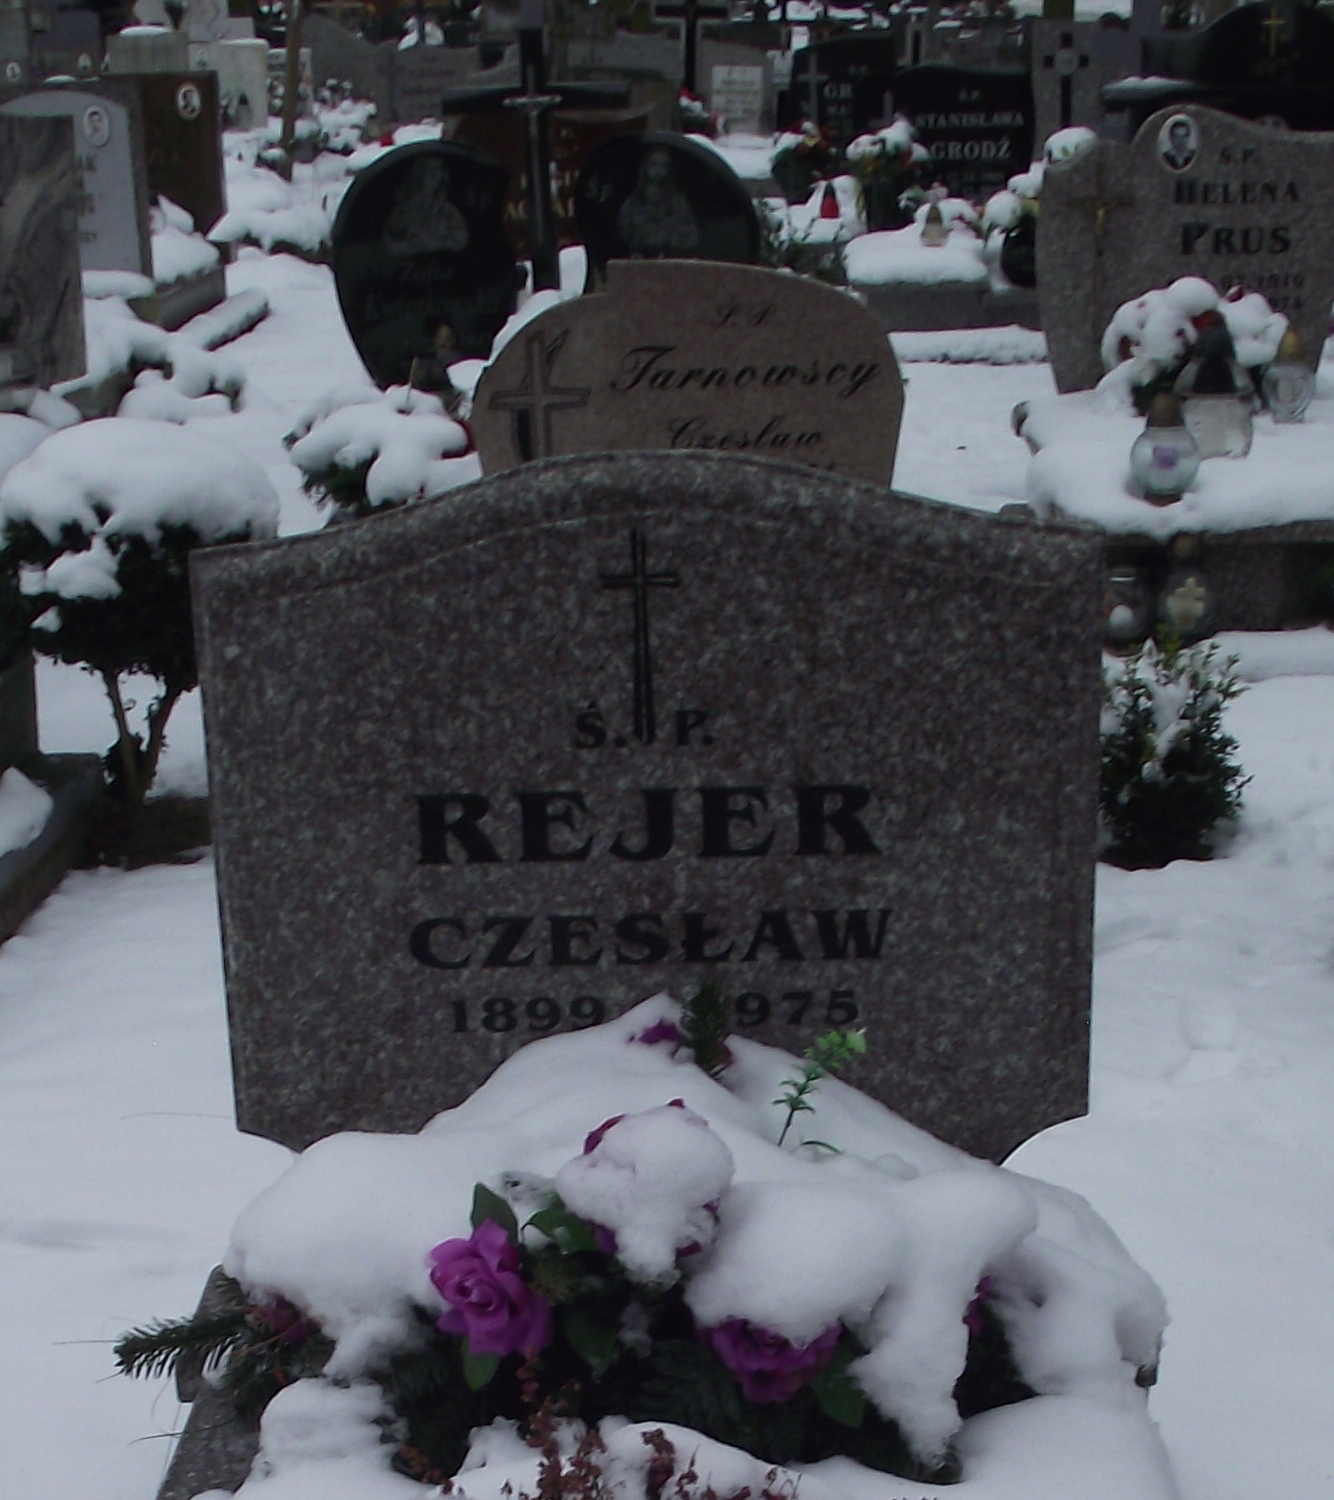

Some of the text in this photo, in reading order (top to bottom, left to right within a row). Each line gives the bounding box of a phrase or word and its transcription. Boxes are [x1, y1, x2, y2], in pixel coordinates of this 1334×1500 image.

[930, 136, 1012, 160] GRODŹ
[1173, 177, 1301, 205] HELENA
[1180, 221, 1292, 256] PRUS
[610, 345, 882, 400] Tarnowscy
[413, 783, 883, 866] REJER
[408, 907, 893, 971] CZESŁAW
[450, 989, 861, 1036] 1899 975
